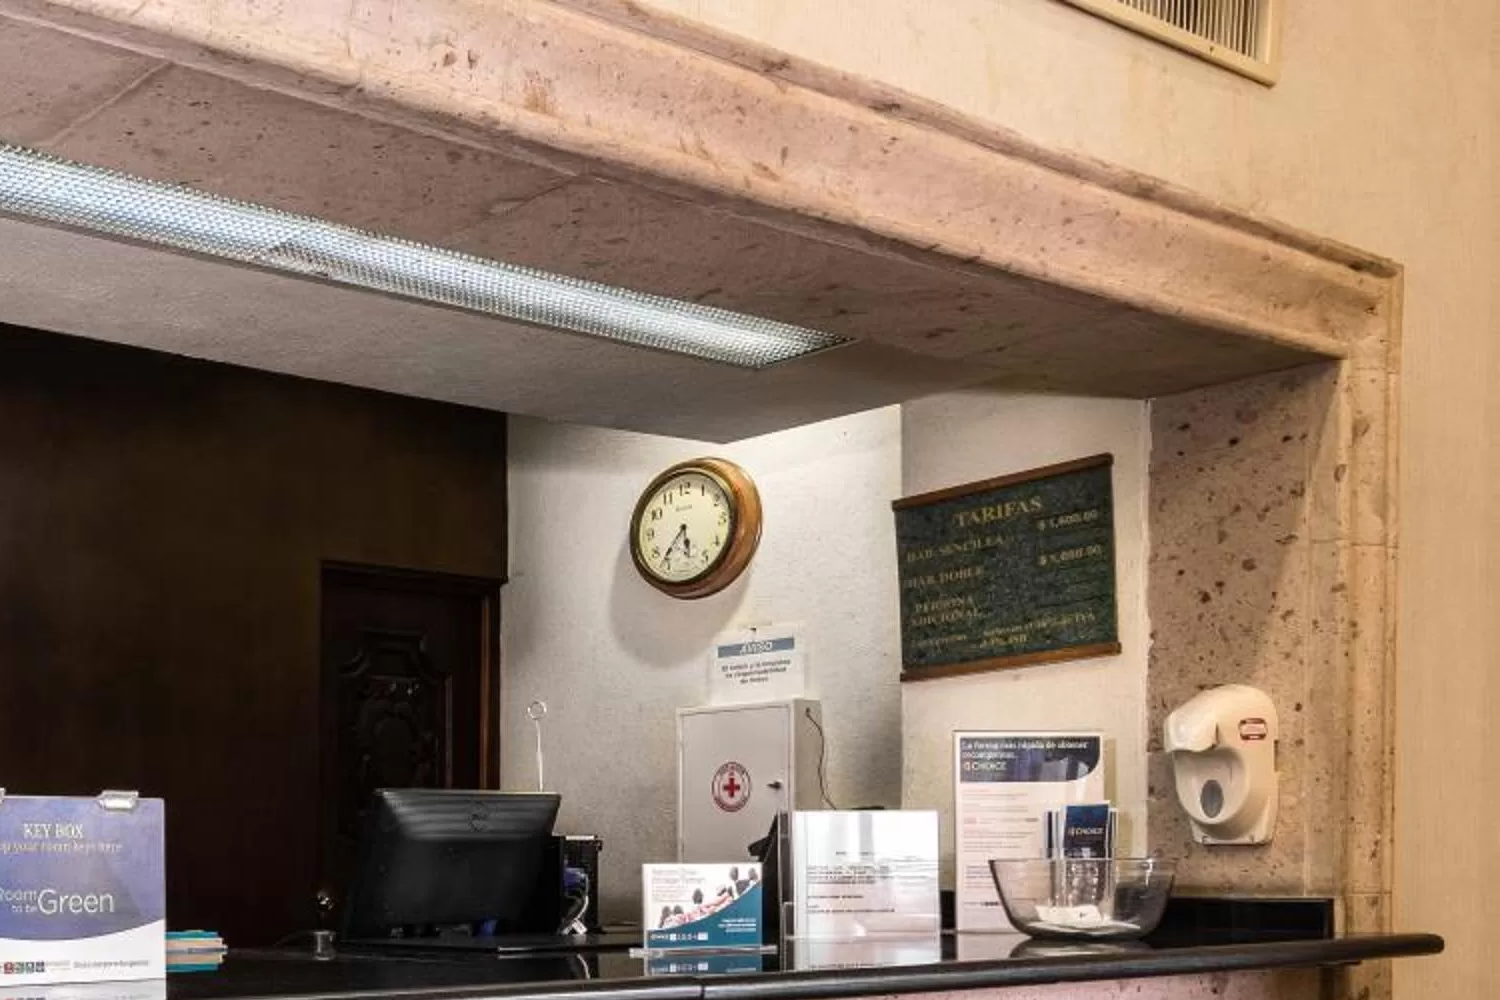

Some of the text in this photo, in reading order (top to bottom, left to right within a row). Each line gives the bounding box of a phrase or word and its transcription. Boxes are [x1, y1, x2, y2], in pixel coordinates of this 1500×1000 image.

[953, 496, 1043, 527] TARIFAS
[23, 823, 84, 839] KEY BOX
[37, 888, 115, 915] Green
